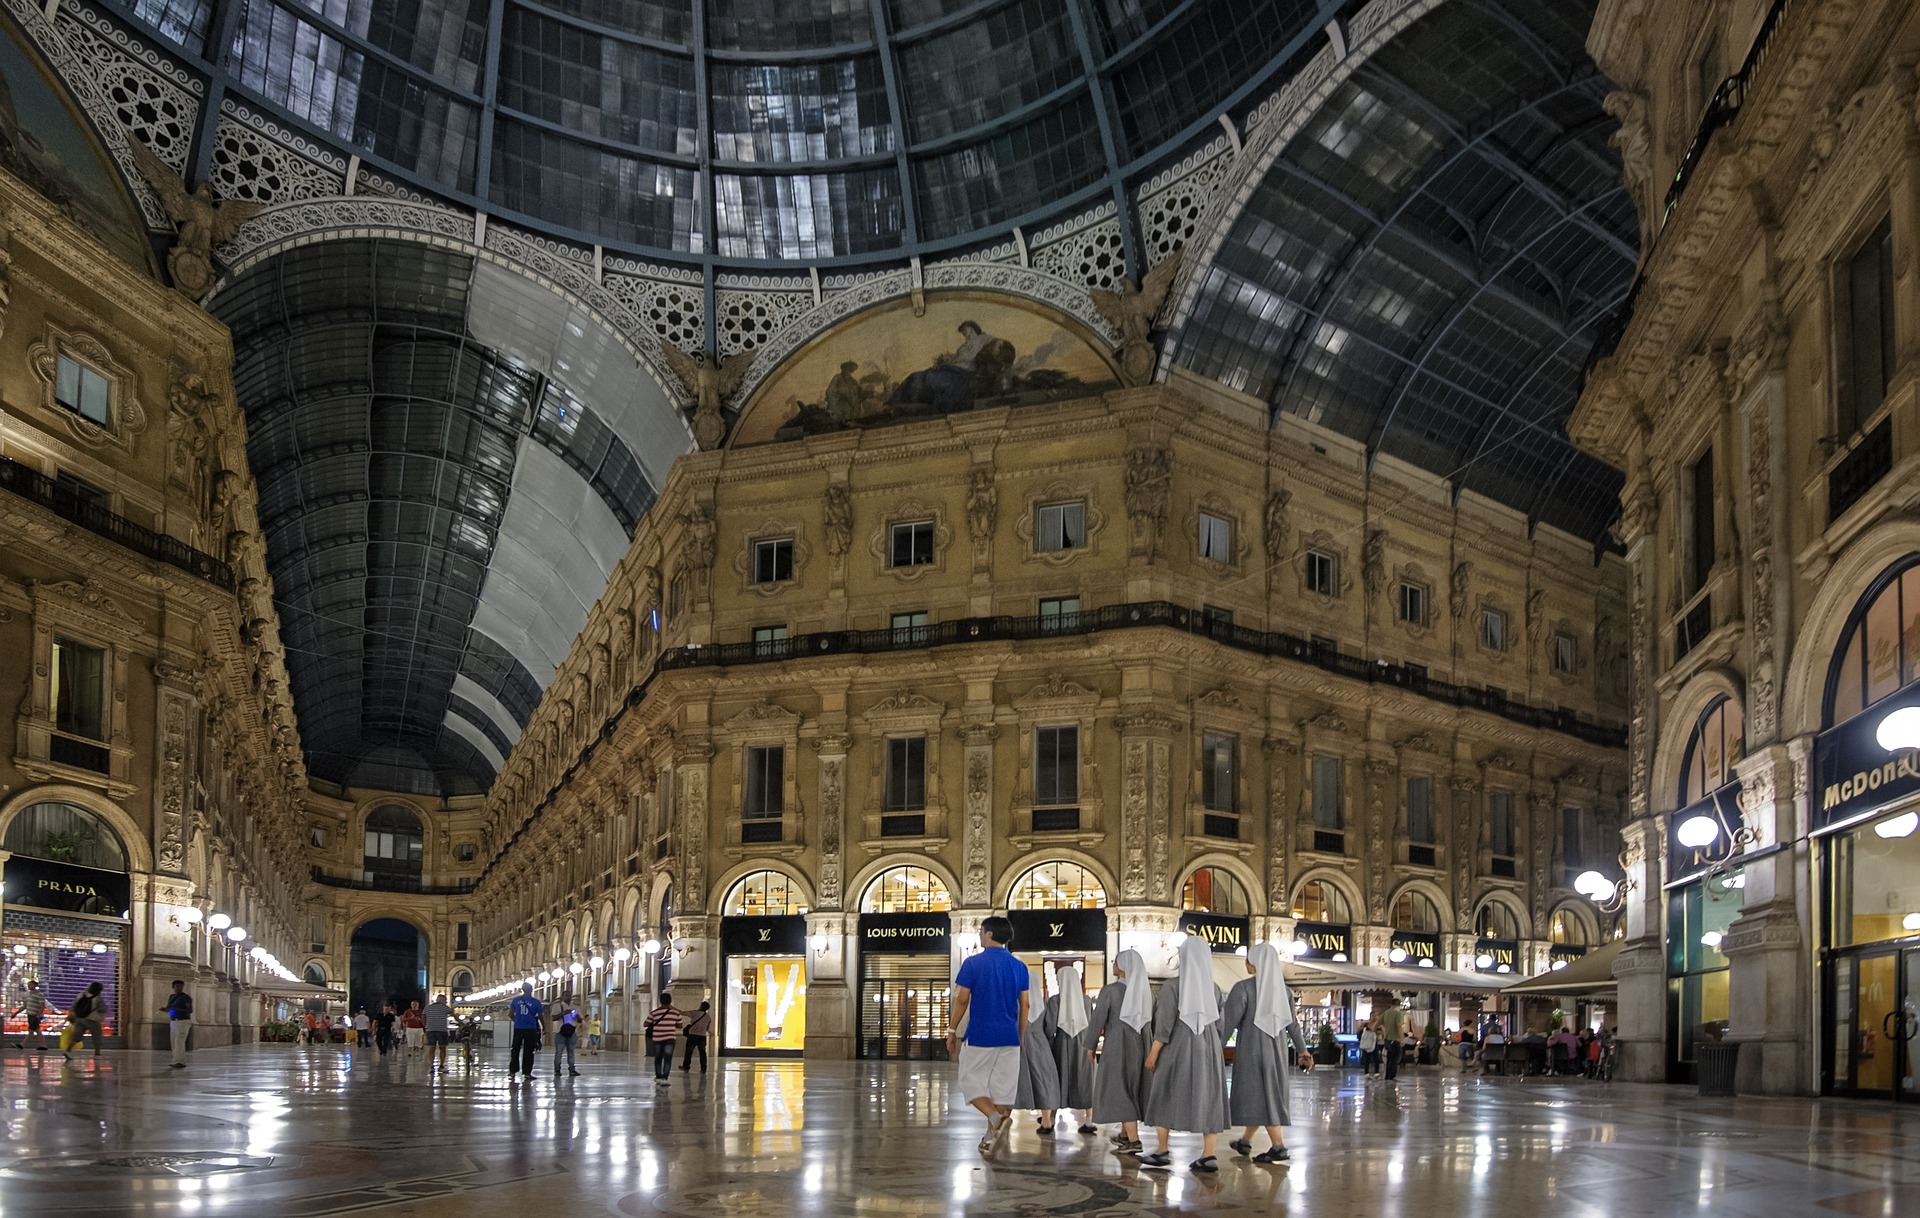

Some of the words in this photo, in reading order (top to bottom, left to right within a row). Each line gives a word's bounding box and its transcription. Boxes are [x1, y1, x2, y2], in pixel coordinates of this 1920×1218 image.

[38, 879, 97, 896] PRADA
[867, 928, 898, 938] LOUIS
[899, 927, 945, 937] VUITTON
